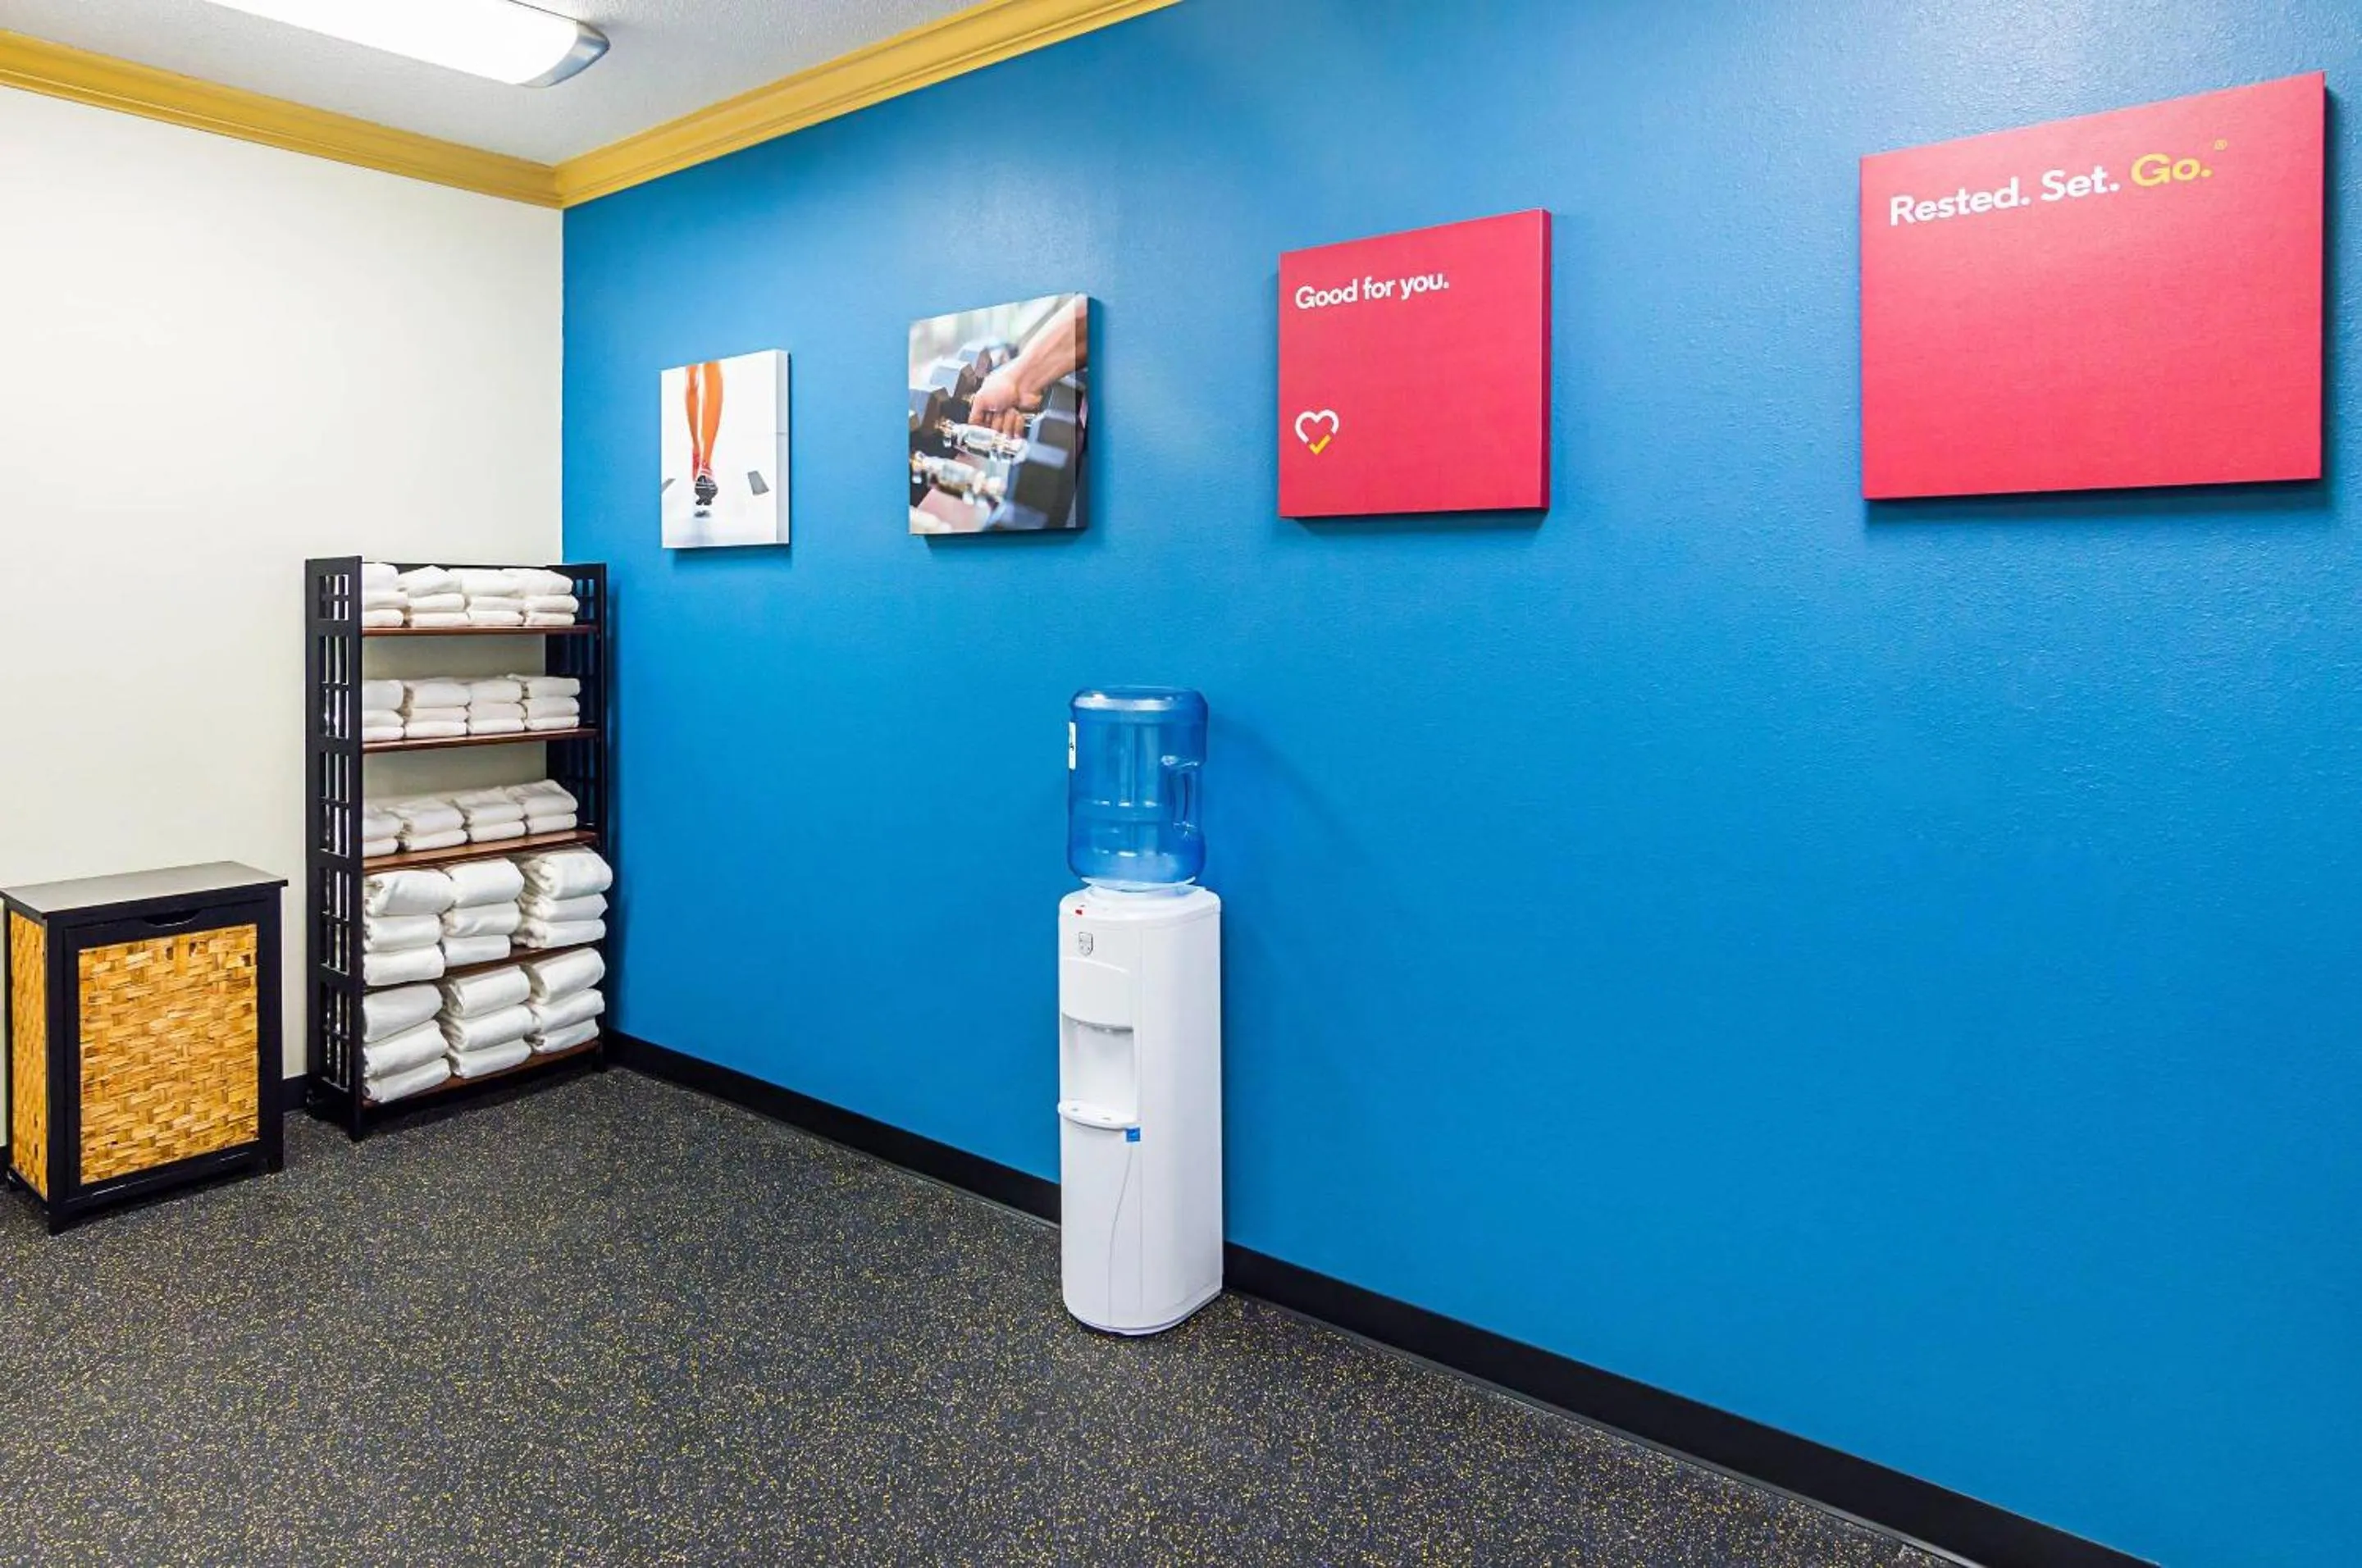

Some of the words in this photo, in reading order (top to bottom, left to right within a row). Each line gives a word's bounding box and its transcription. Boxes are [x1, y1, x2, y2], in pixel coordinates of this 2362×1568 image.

[1890, 176, 2031, 226] Rested.
[2041, 166, 2120, 202] Set.
[1295, 279, 1358, 309] Good
[1363, 276, 1396, 299] for
[1400, 273, 1449, 300] you.
